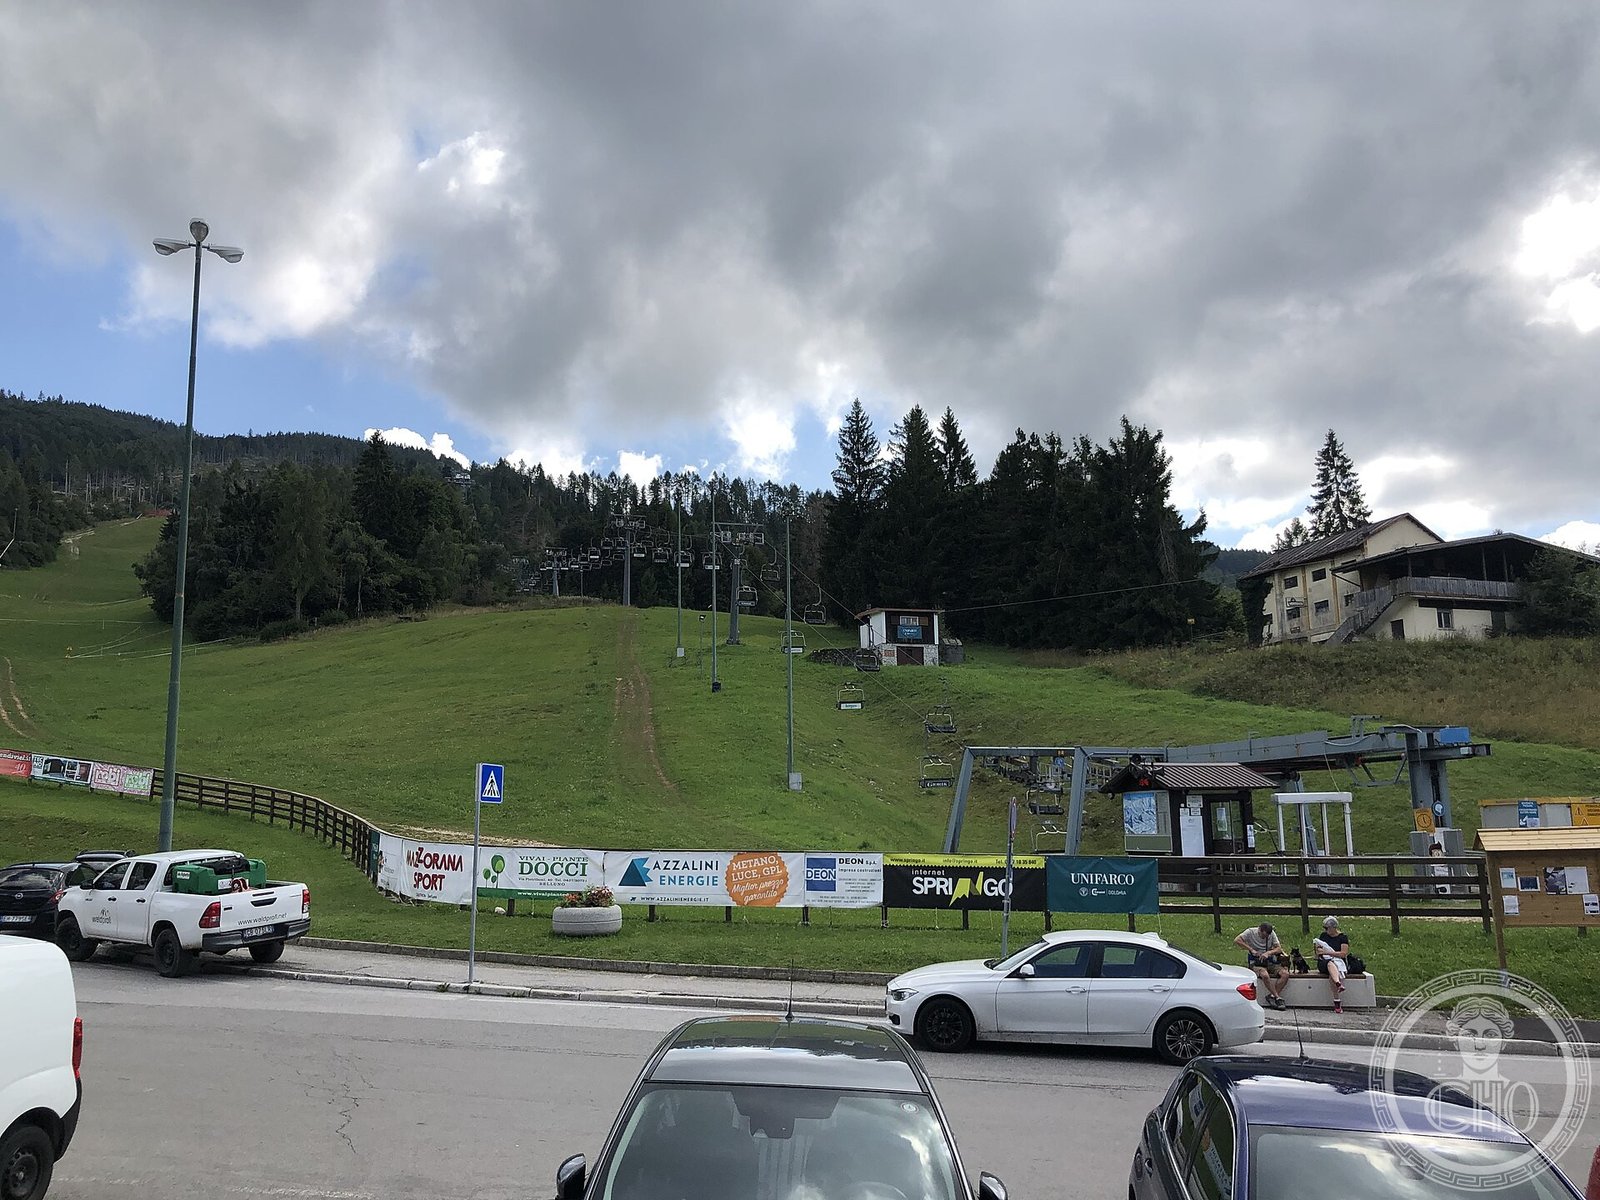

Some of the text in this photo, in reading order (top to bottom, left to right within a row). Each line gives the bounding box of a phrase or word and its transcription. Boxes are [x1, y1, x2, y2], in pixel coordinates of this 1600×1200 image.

[406, 846, 463, 872] MAZZORANA
[652, 860, 719, 871] AZZALINI
[732, 855, 779, 871] METANO,
[518, 861, 588, 877] DOCCI
[731, 865, 783, 882] LUCE, GPL
[806, 869, 836, 880] DEON
[911, 868, 945, 876] internet
[413, 871, 446, 891] SPORT
[659, 875, 719, 886] ENERGIE
[731, 878, 784, 896] Miglior prezzo
[1070, 872, 1135, 886] UNIFARCO
[743, 889, 778, 905] garantito
